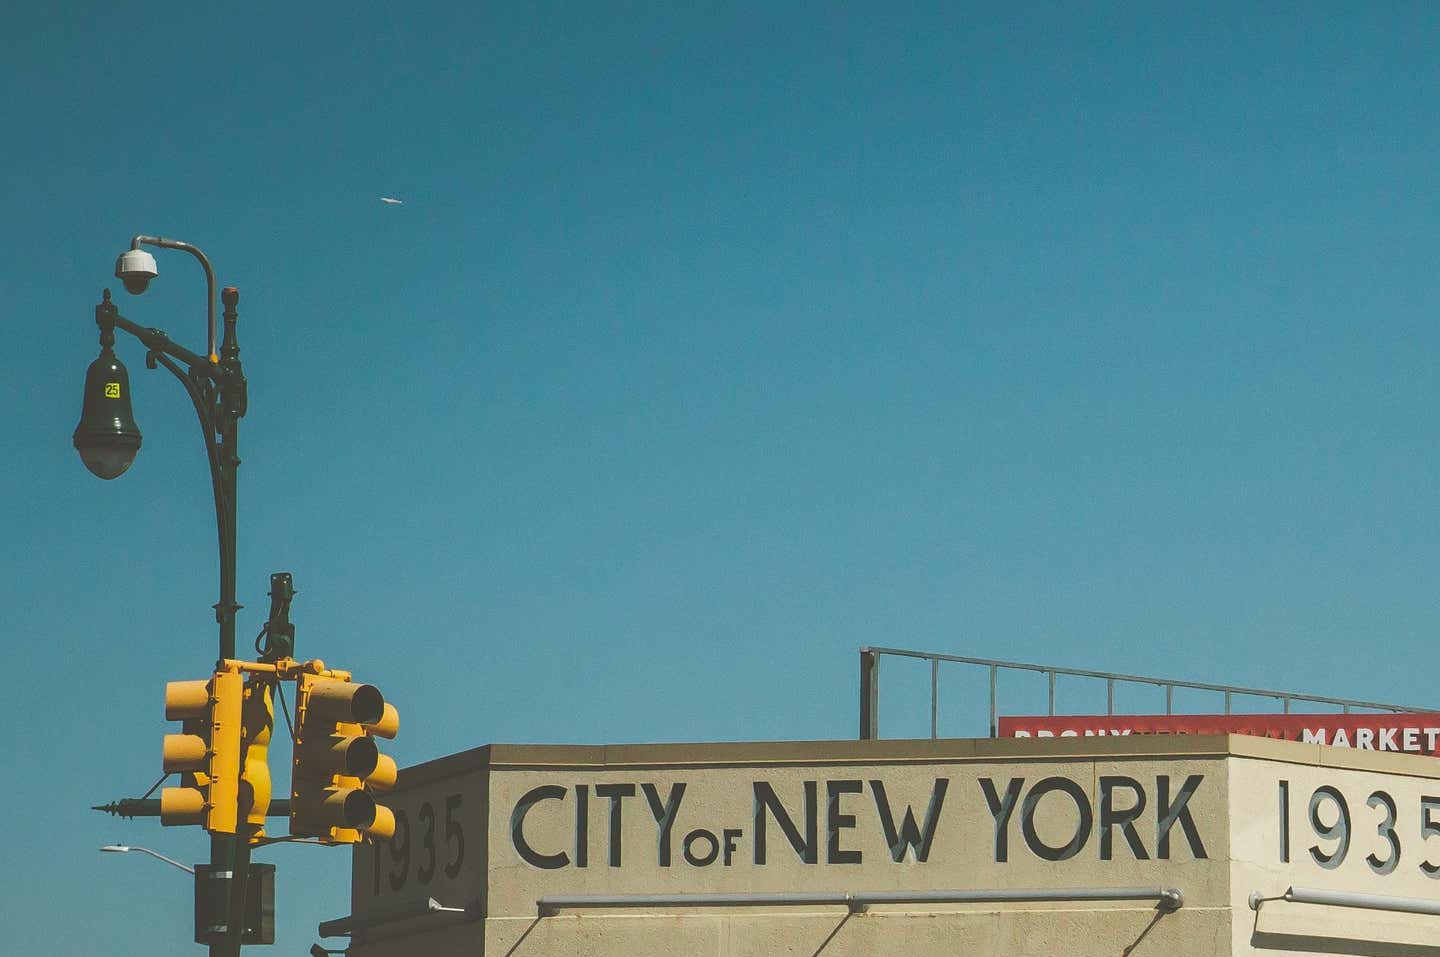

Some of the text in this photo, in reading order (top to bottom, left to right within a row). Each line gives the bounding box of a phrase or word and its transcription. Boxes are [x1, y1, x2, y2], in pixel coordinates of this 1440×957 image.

[106, 384, 119, 396] 25
[1302, 727, 1440, 751] MARKET
[509, 774, 1209, 870] CITY OF NEW YORK
